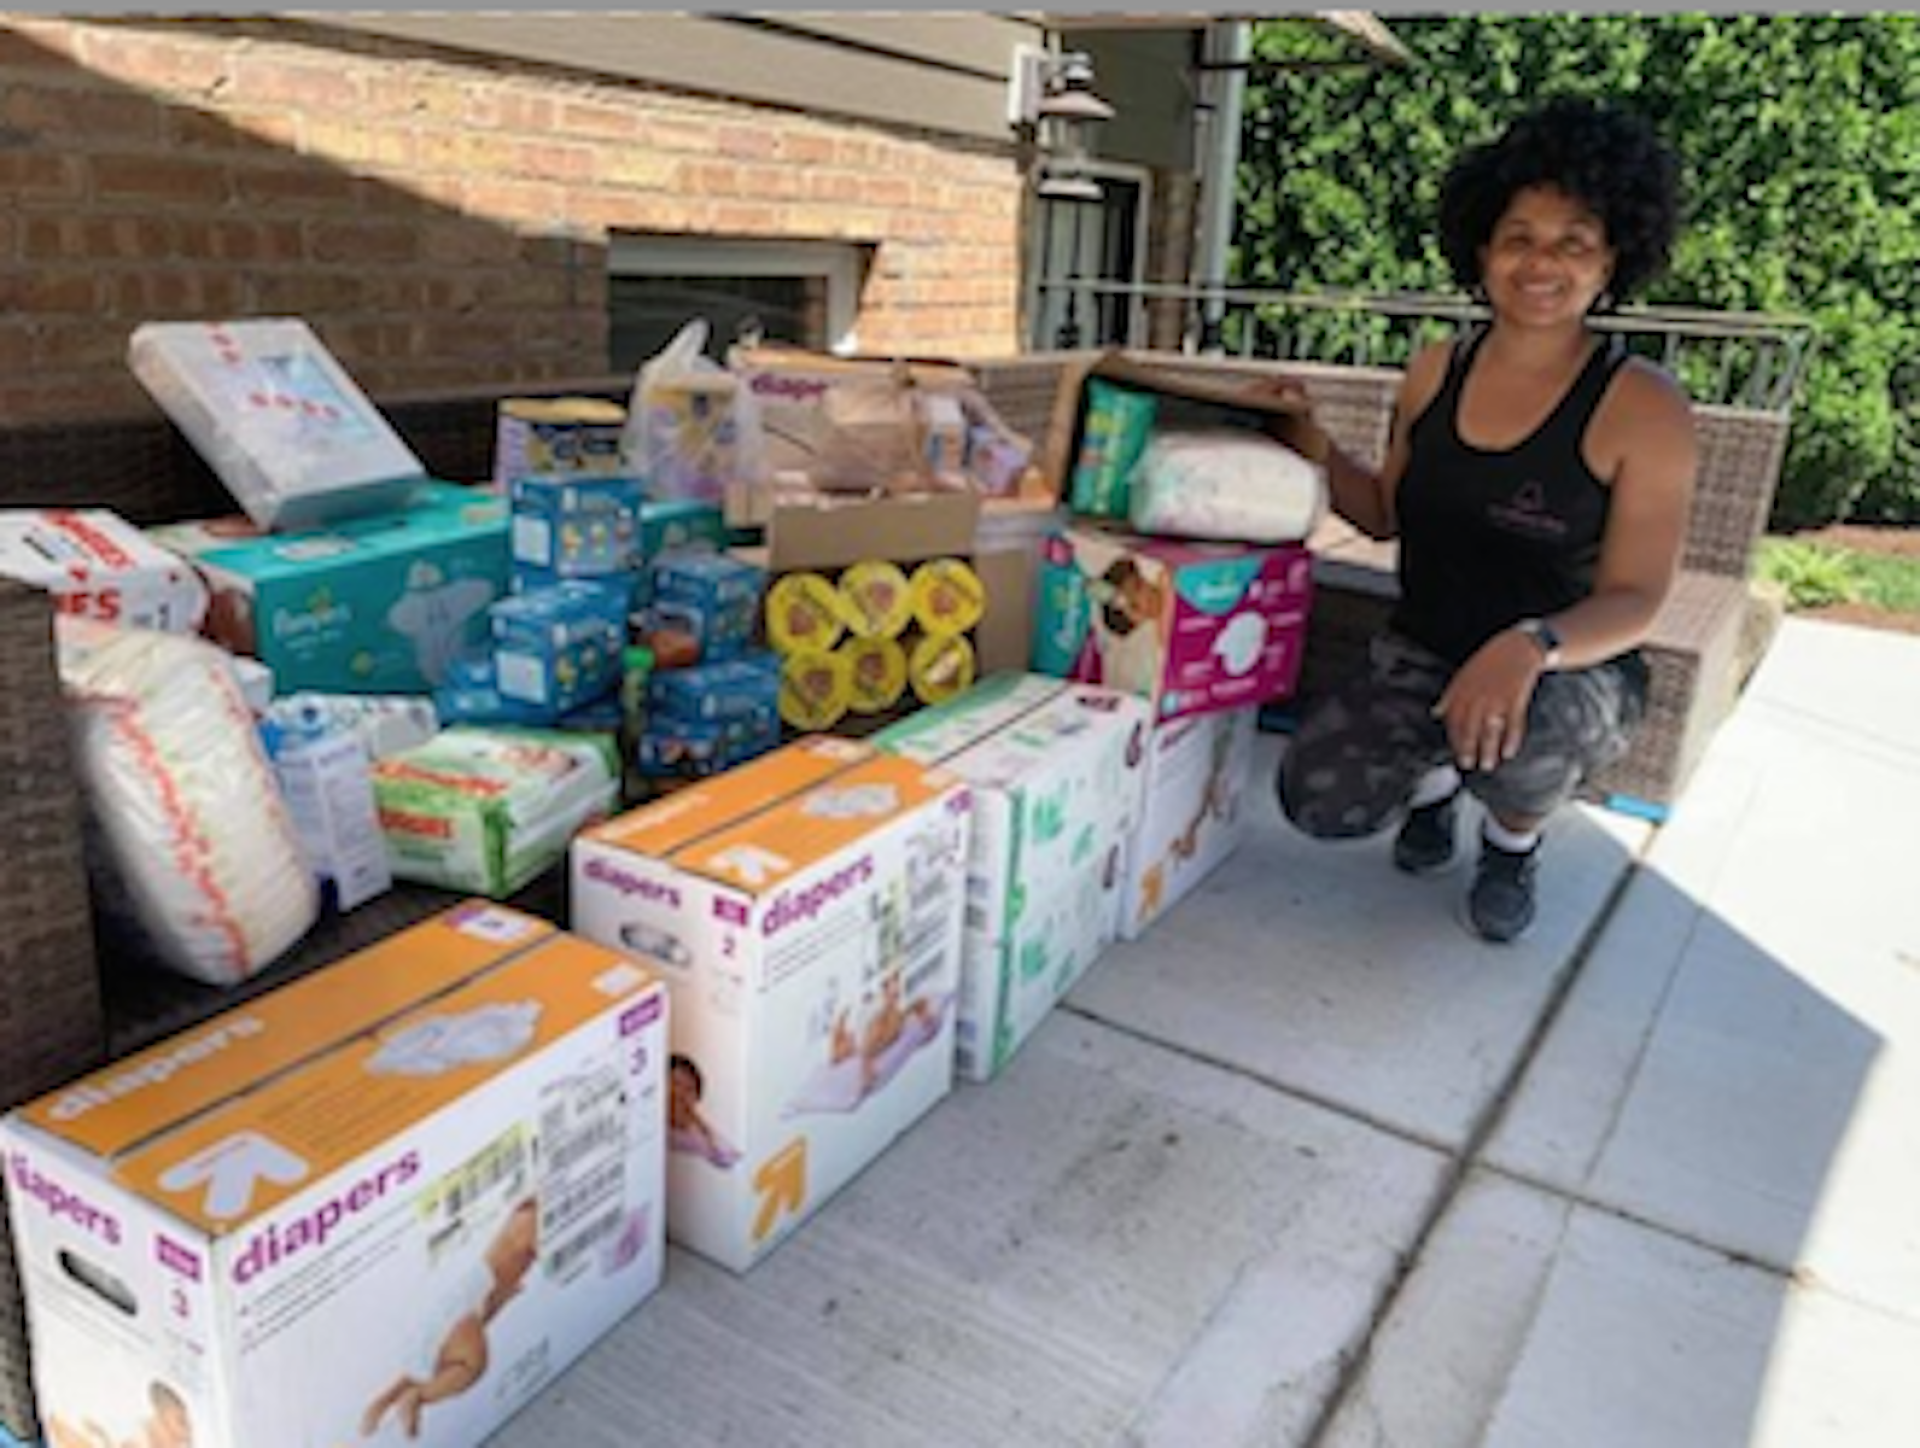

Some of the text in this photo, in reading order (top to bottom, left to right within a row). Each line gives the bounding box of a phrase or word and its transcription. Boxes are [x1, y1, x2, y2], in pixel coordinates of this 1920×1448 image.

[584, 857, 682, 910] diapers
[762, 853, 874, 938] diapers
[48, 1015, 263, 1120] diapers
[10, 1152, 121, 1244] iapers
[231, 1150, 420, 1284] diapers
